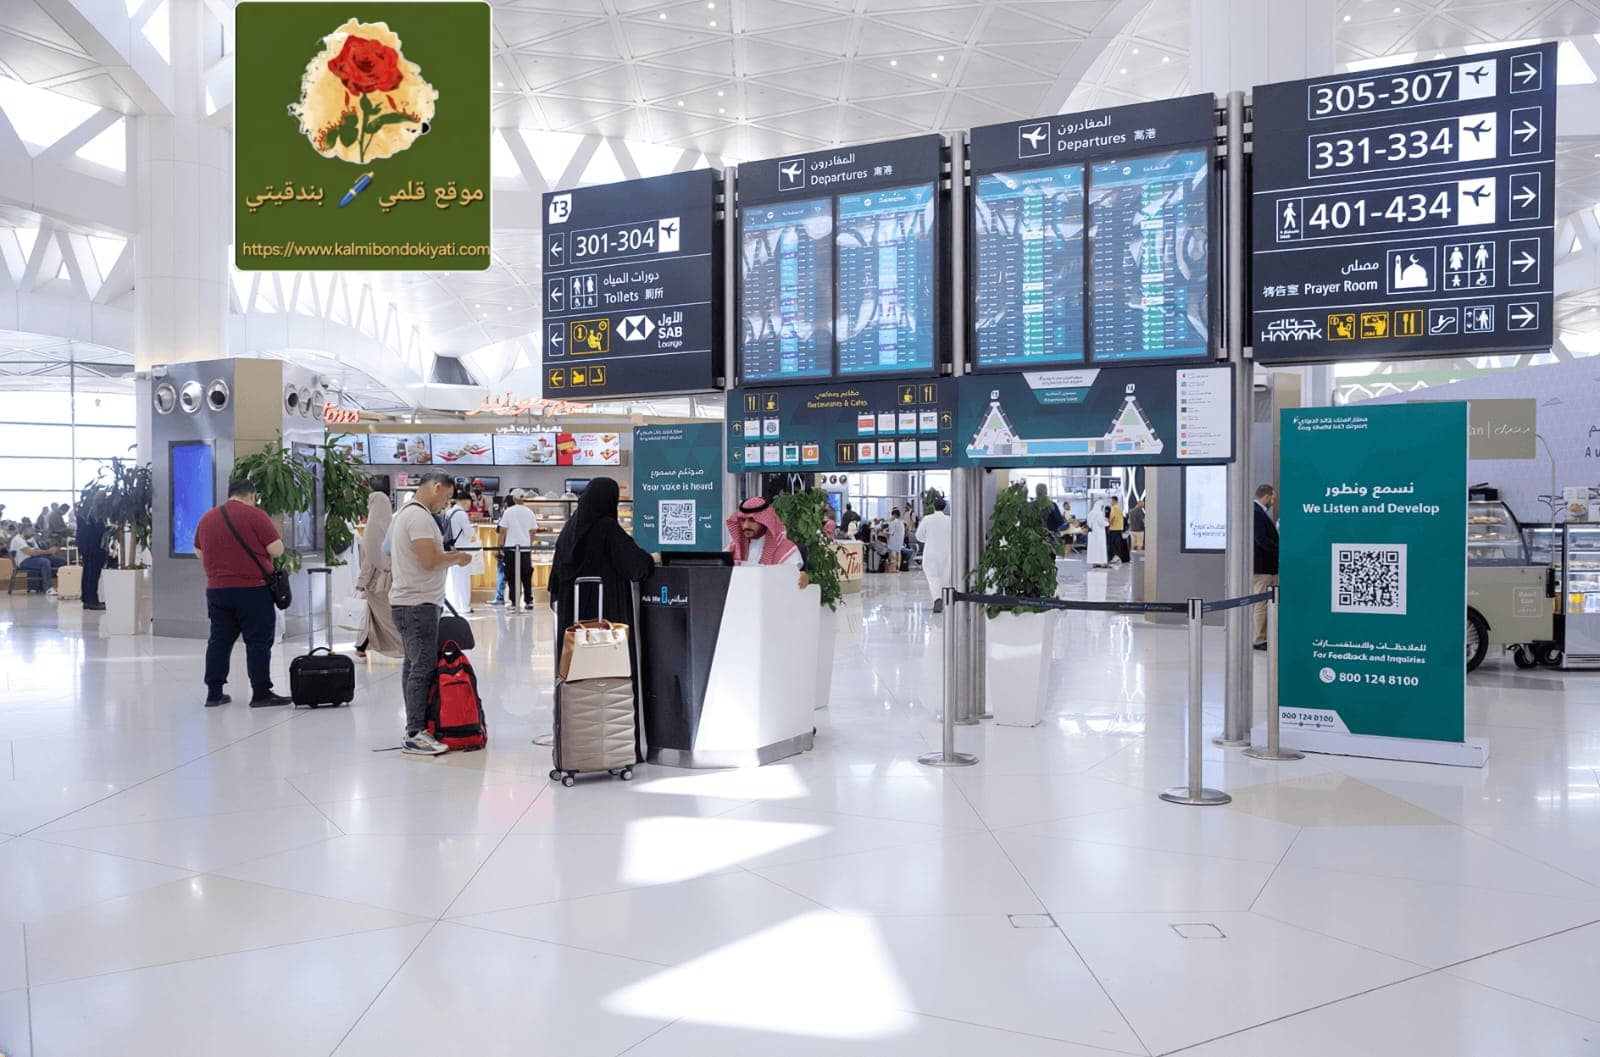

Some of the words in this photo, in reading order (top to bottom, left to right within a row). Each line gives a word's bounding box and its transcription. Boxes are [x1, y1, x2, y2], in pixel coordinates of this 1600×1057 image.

[1315, 71, 1453, 115] 305-307
[1057, 114, 1112, 136] المغادرون
[1057, 133, 1127, 152] Departures
[1315, 127, 1454, 170] 331-334
[810, 152, 856, 171] المغادرون
[810, 170, 868, 187] Departures
[551, 200, 569, 218] T3
[1309, 191, 1452, 230] 401-434
[575, 227, 656, 257] 301-304
[1341, 258, 1380, 275] مصلى
[603, 271, 629, 287] المياه
[631, 270, 660, 284] دورات
[1304, 283, 1342, 297] Prayer
[1343, 279, 1379, 293] Room
[603, 290, 639, 304] Toilets
[658, 326, 683, 339] SAB
[642, 483, 659, 491] Your
[661, 482, 681, 491] voice
[683, 482, 688, 490] is
[690, 481, 713, 490] heard
[1325, 483, 1368, 497] ونطور
[1372, 482, 1414, 498] نسمع
[1302, 503, 1321, 513] We
[1323, 503, 1359, 513] Listen
[1361, 502, 1385, 513] and
[1387, 502, 1440, 516] Develop
[1313, 651, 1326, 659] For
[1328, 652, 1368, 661] Feedback
[1369, 654, 1386, 663] and
[1387, 656, 1426, 665] Inquiries
[1339, 672, 1361, 683] 800
[1365, 674, 1386, 685] 124
[1388, 675, 1419, 686] 8100
